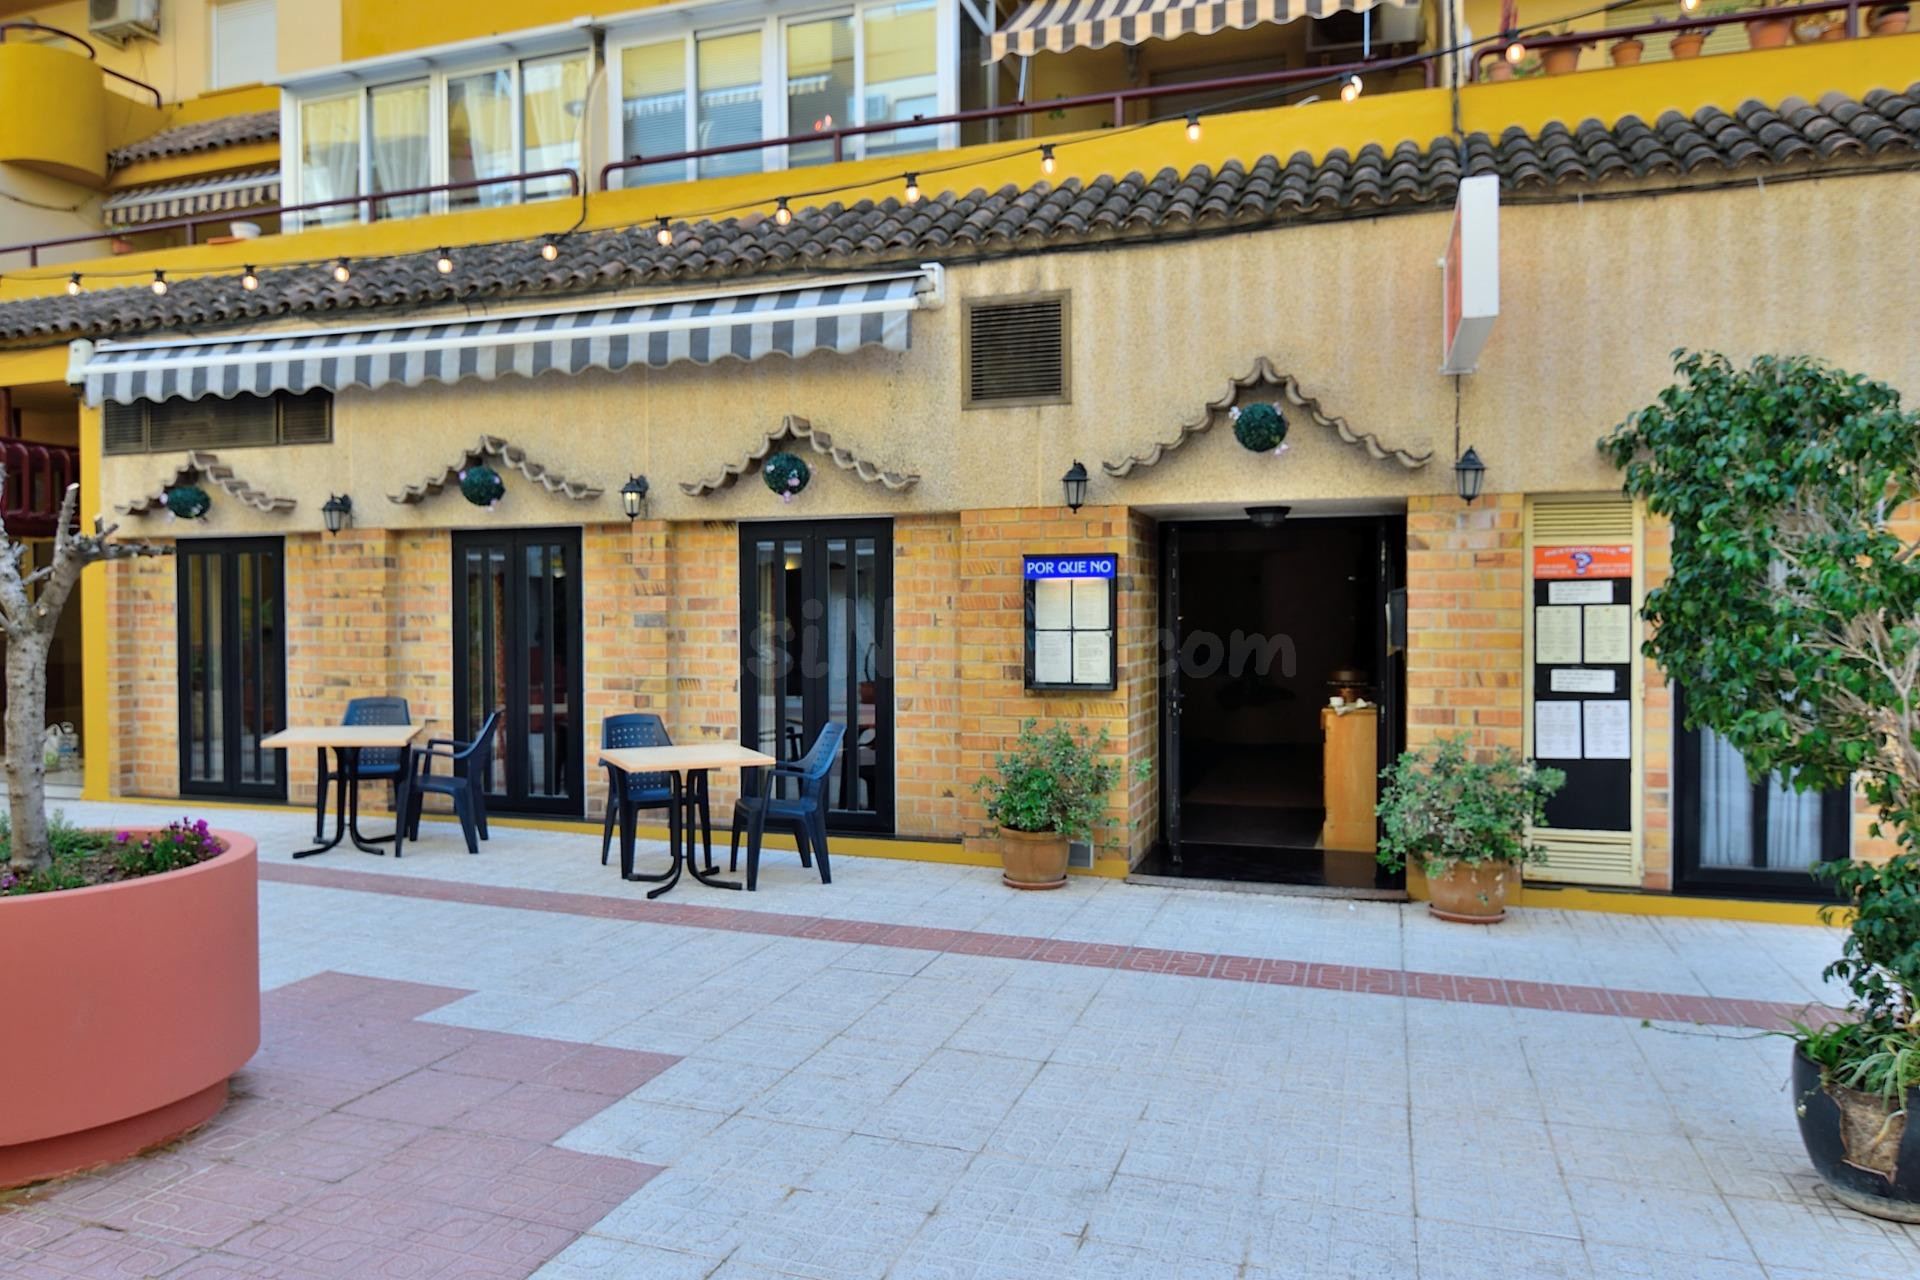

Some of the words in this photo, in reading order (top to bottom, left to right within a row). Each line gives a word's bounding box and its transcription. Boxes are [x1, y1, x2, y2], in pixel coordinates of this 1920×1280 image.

[1026, 562, 1055, 574] POR
[1057, 561, 1087, 574] QUE
[1089, 560, 1112, 573] NO
